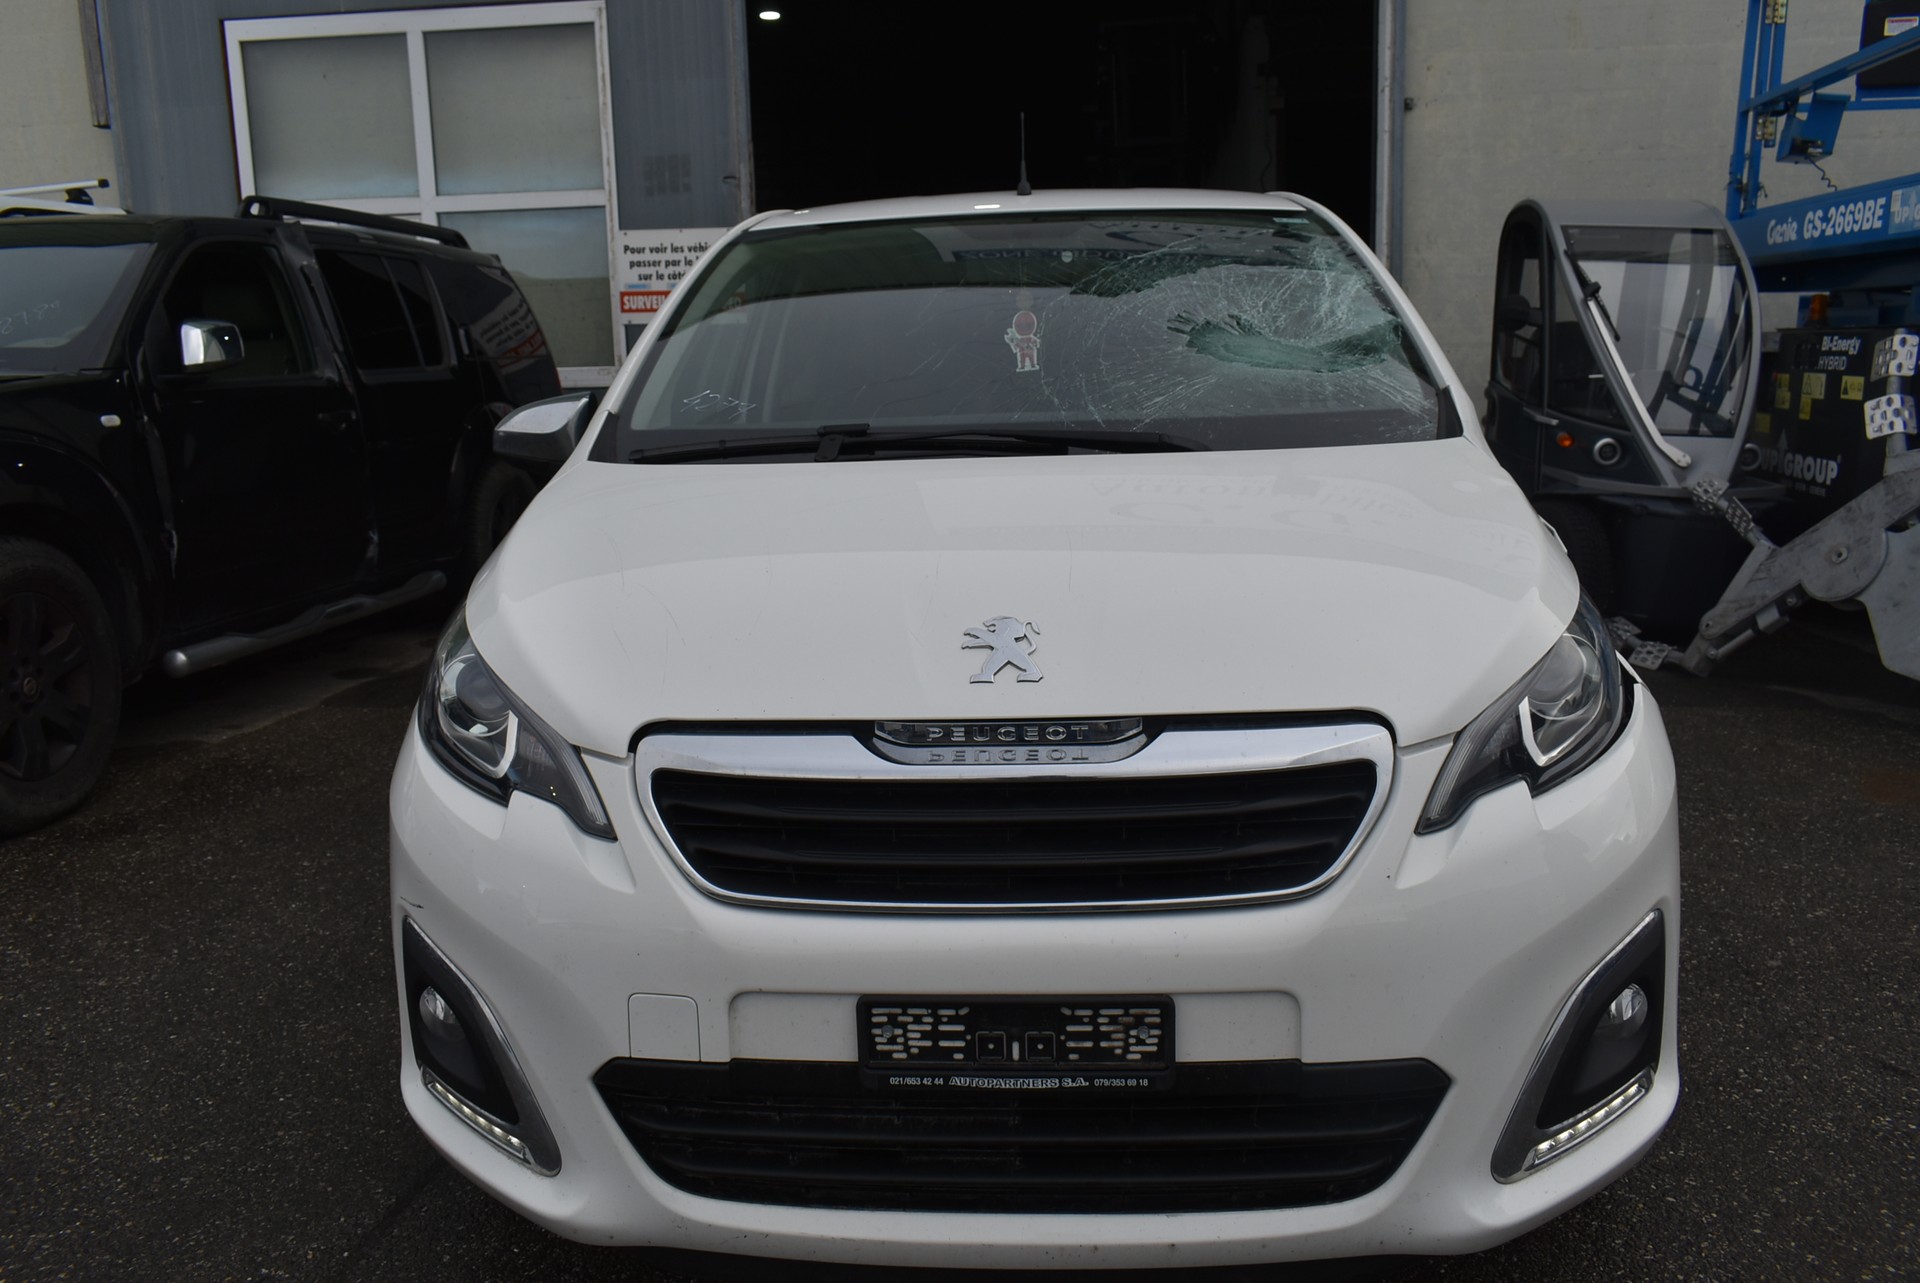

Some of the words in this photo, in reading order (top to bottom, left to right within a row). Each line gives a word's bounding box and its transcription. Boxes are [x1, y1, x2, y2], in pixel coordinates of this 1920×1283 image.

[1767, 217, 1798, 245] Genie
[1803, 197, 1886, 240] GS-2669BE
[624, 245, 646, 255] Pour
[648, 243, 668, 254] voir
[671, 243, 684, 253] les
[629, 259, 662, 269] passer
[665, 259, 681, 269] par
[684, 256, 693, 266] le
[638, 273, 652, 281] sur
[656, 270, 665, 280] le
[1821, 336, 1861, 355] Bi-Energy
[1818, 356, 1847, 370] HYBRID
[1783, 452, 1839, 486] GROUP
[927, 725, 1089, 742] PEUGEOT
[889, 1076, 921, 1085] 021/653
[922, 1077, 934, 1085] 42
[934, 1077, 944, 1085] 44
[949, 1076, 1060, 1088] AUTOPARTNERS
[1094, 1078, 1127, 1087] 079/353
[1128, 1078, 1137, 1087] 69
[1139, 1078, 1149, 1087] 18
